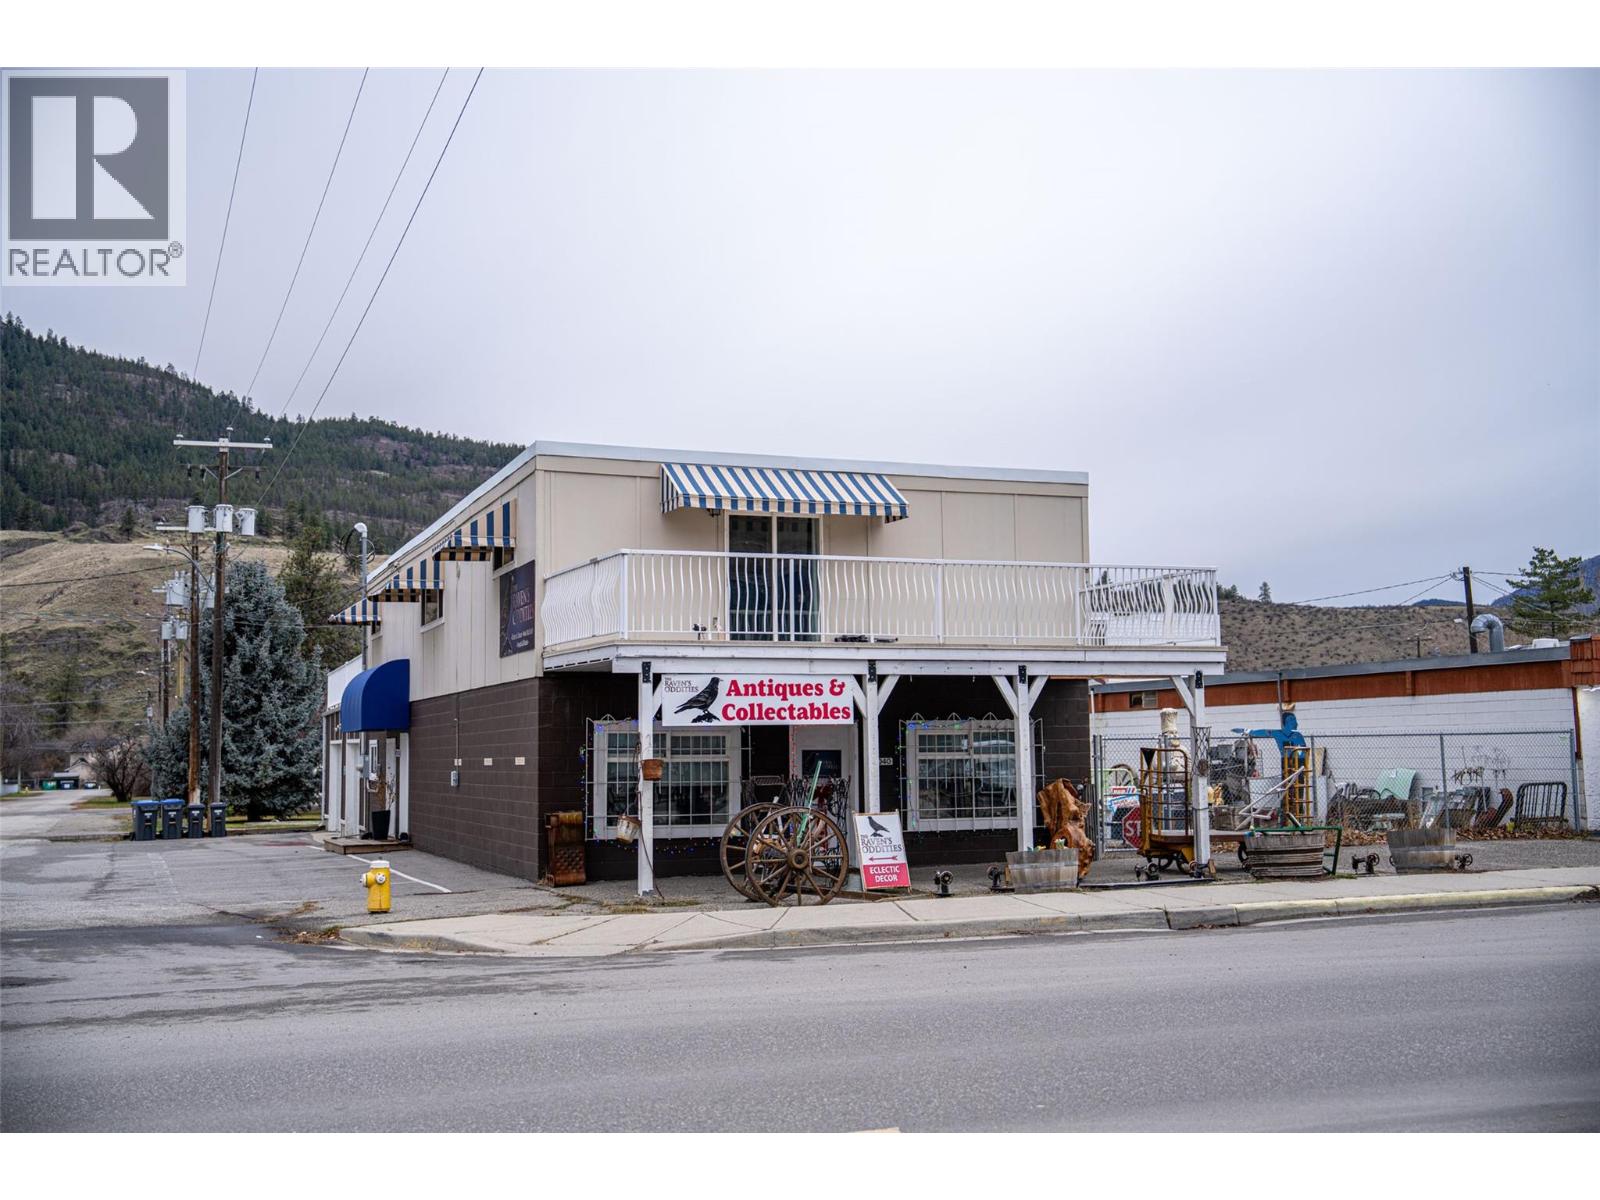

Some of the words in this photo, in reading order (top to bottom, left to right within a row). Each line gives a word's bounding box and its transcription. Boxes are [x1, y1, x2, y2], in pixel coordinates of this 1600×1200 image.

[726, 680, 823, 701] Antiques
[829, 678, 846, 696] &
[721, 703, 850, 721] Collectables
[862, 838, 893, 846] RAVEN'S
[862, 845, 902, 853] ODDITIES
[870, 866, 900, 874] ECLECTIC
[875, 875, 897, 883] DECOR
